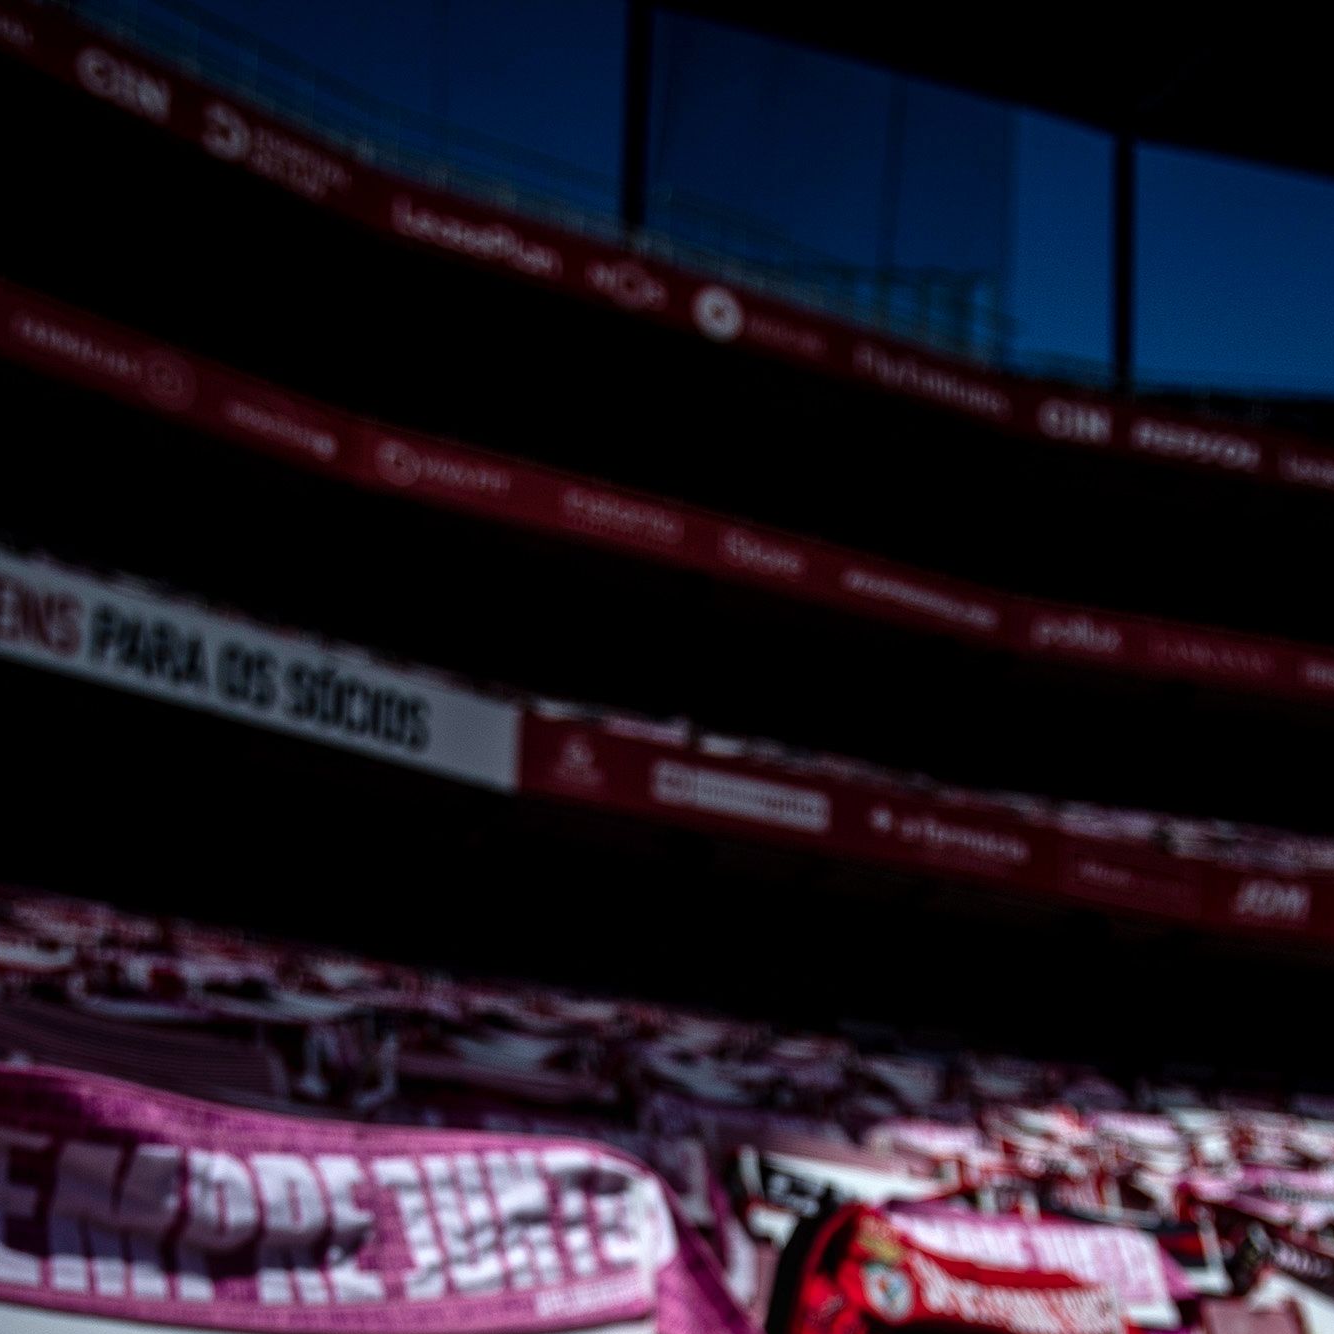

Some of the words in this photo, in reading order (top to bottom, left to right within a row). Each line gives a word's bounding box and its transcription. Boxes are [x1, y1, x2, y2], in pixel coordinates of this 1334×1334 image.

[89, 605, 210, 688] PARA
[216, 638, 276, 709] OS
[283, 653, 432, 755] SÓCIOS
